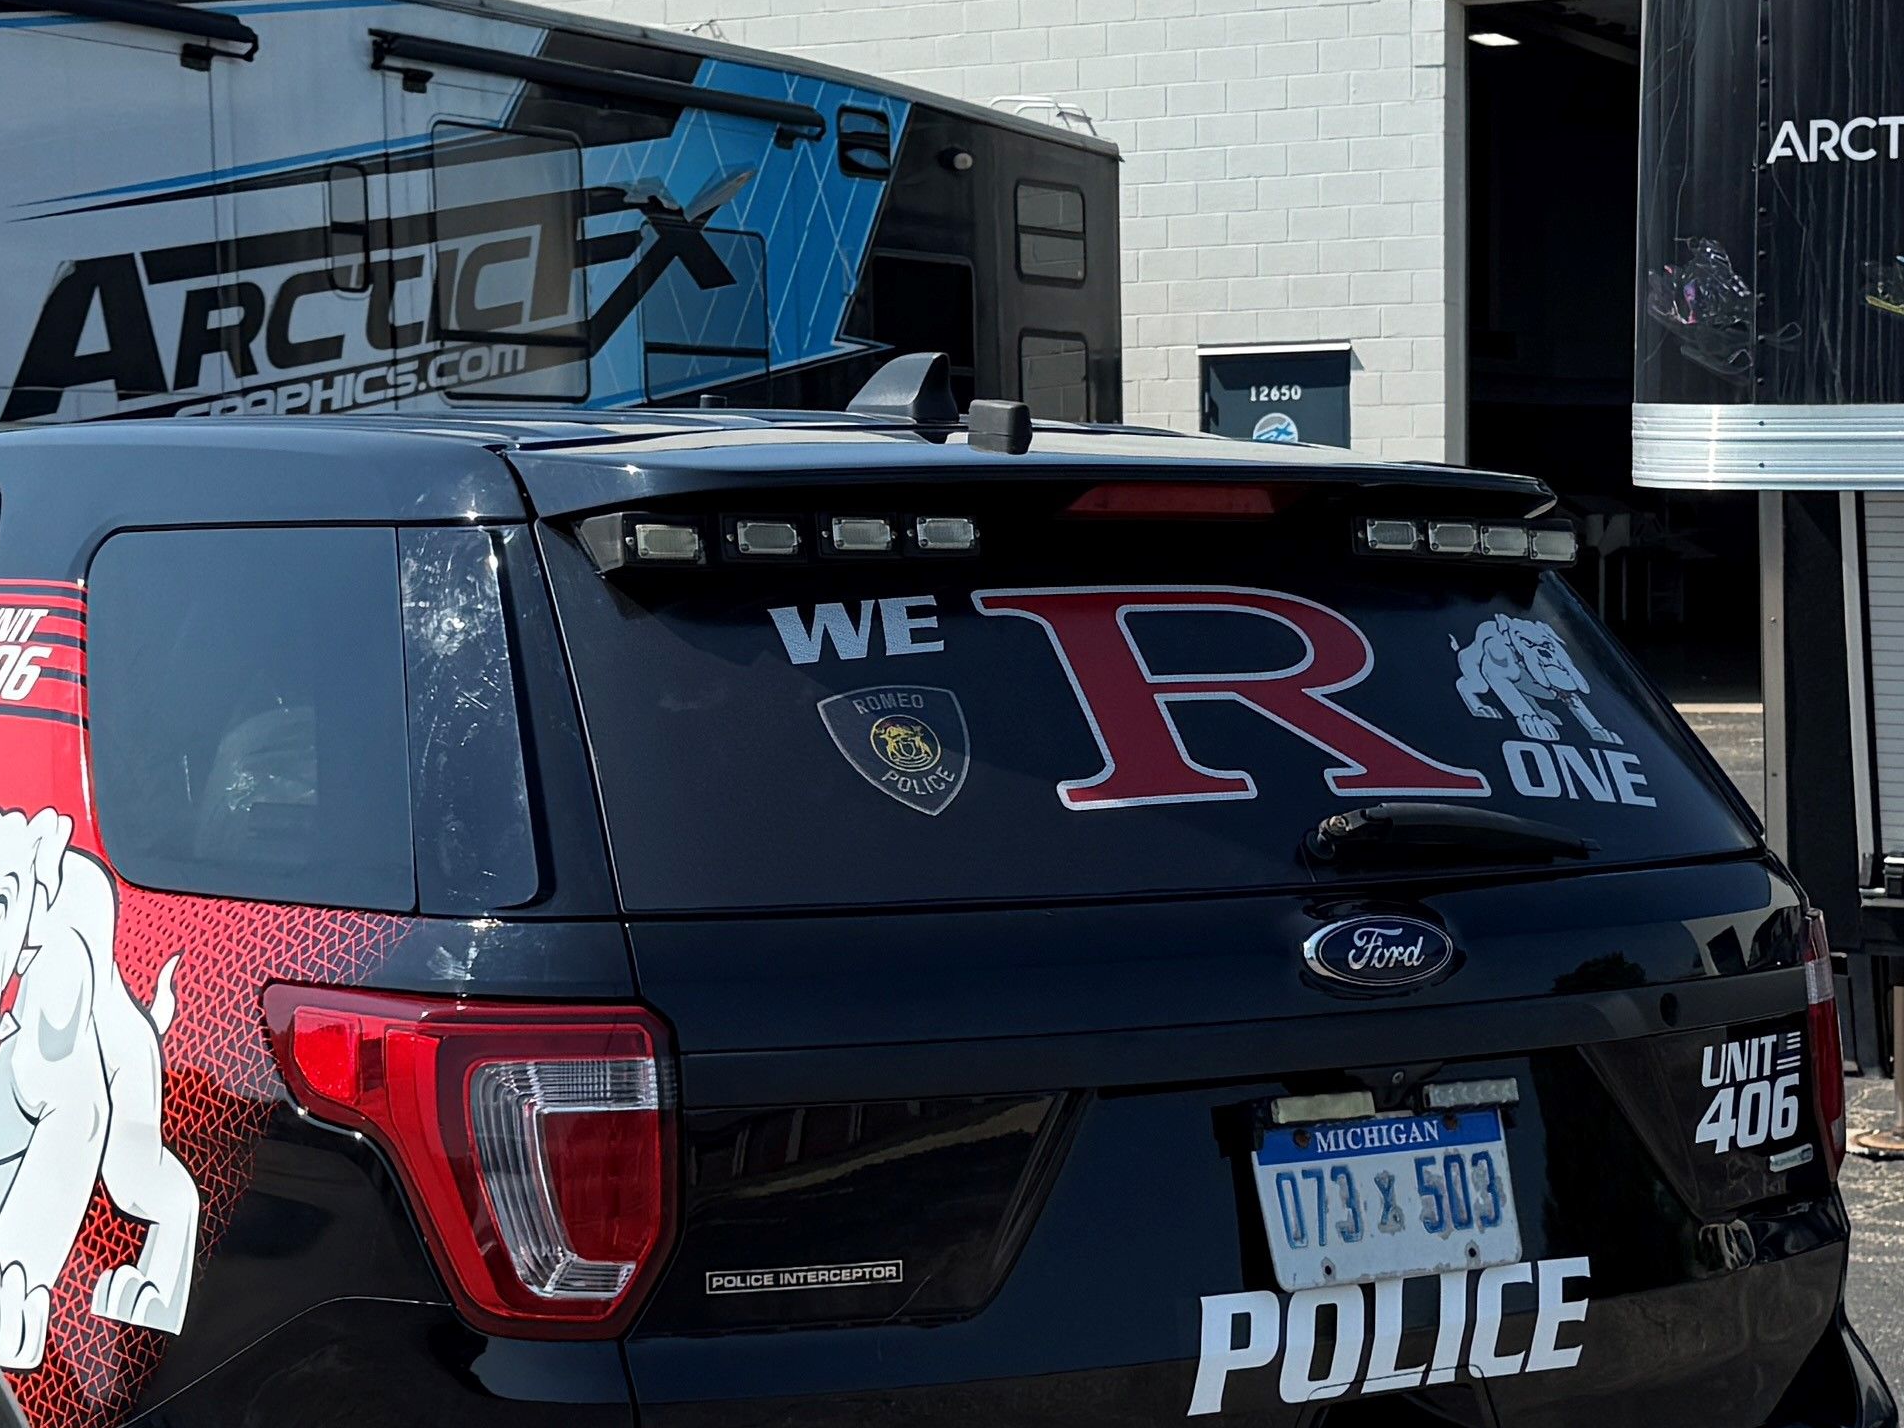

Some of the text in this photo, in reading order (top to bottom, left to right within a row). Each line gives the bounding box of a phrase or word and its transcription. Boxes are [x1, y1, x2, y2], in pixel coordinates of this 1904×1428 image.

[1249, 384, 1303, 402] 12650
[767, 584, 1657, 811] WE R ONE
[852, 692, 924, 715] ROMEO
[881, 766, 956, 795] POLICE
[1348, 927, 1424, 971] Ford
[1701, 1034, 1778, 1088] UNIT
[1695, 1072, 1800, 1154] 406
[1315, 1120, 1440, 1153] MICHIGAN
[1276, 1165, 1364, 1249] 073
[1414, 1150, 1507, 1235] 503
[712, 1266, 897, 1289] POLICE INTERCEPTOR
[1187, 1256, 1591, 1416] POLICE
